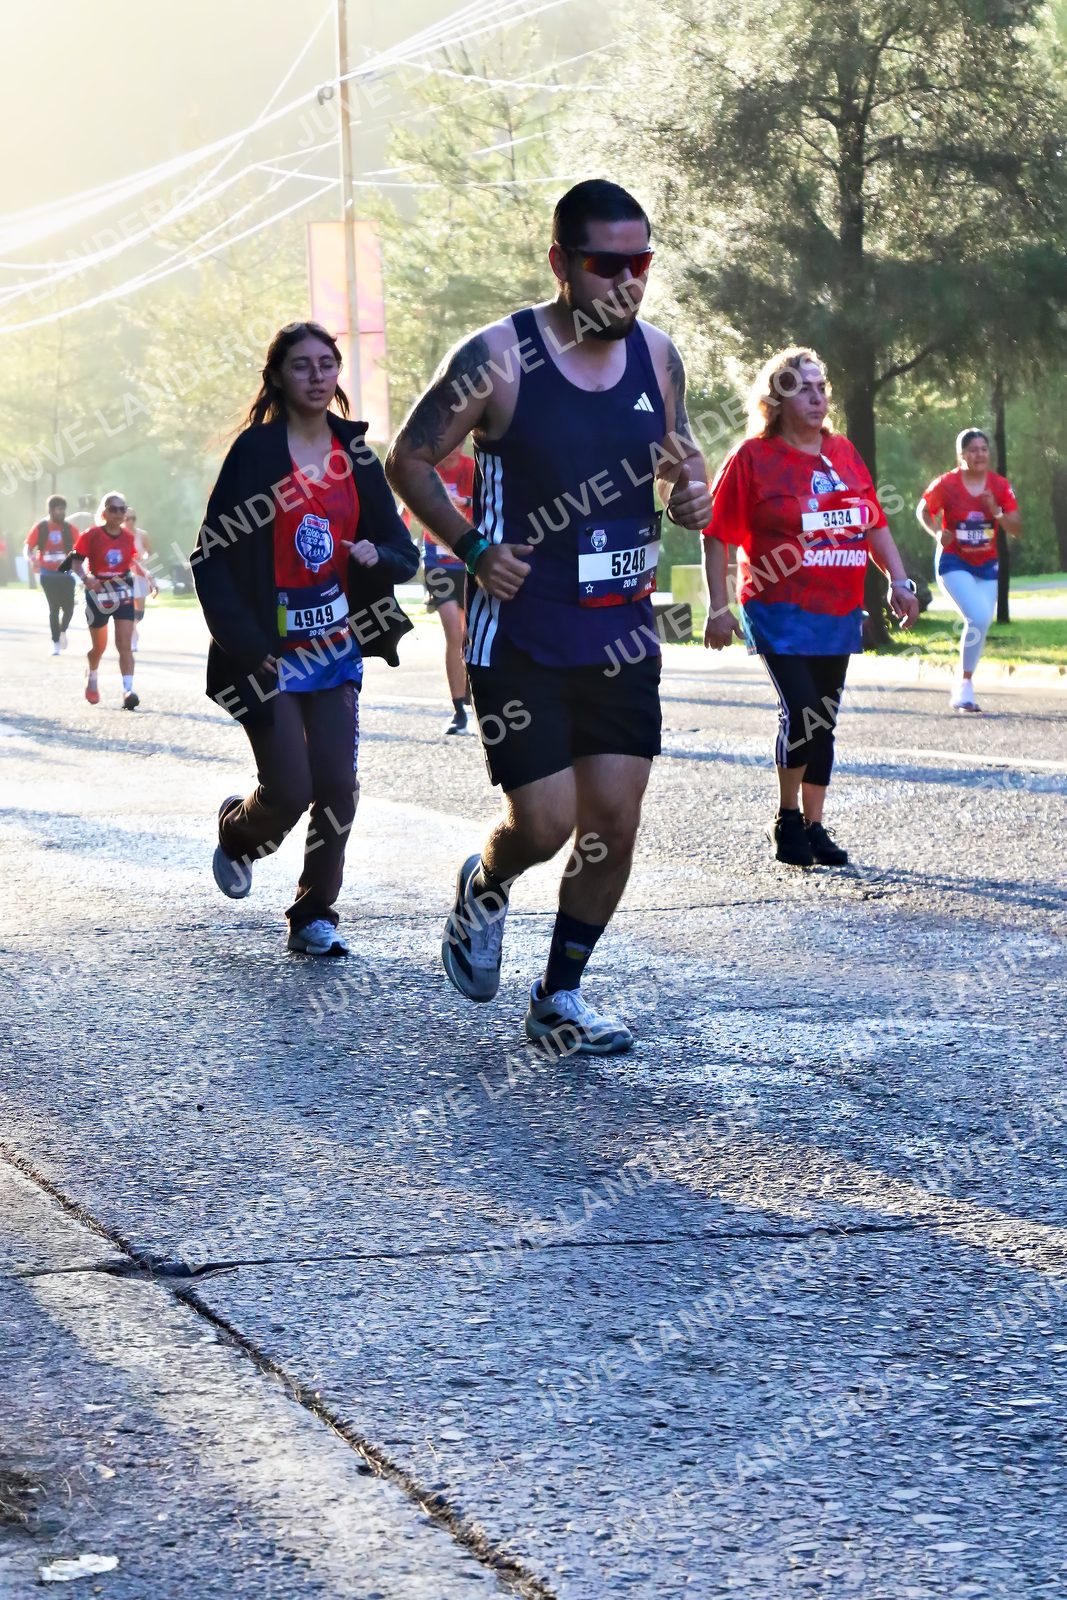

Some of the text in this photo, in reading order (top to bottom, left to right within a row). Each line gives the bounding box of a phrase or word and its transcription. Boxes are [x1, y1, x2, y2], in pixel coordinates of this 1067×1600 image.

[823, 510, 852, 527] 3434
[611, 548, 646, 577] 5248
[802, 549, 867, 567] SANTIAGO
[294, 604, 334, 628] 4949
